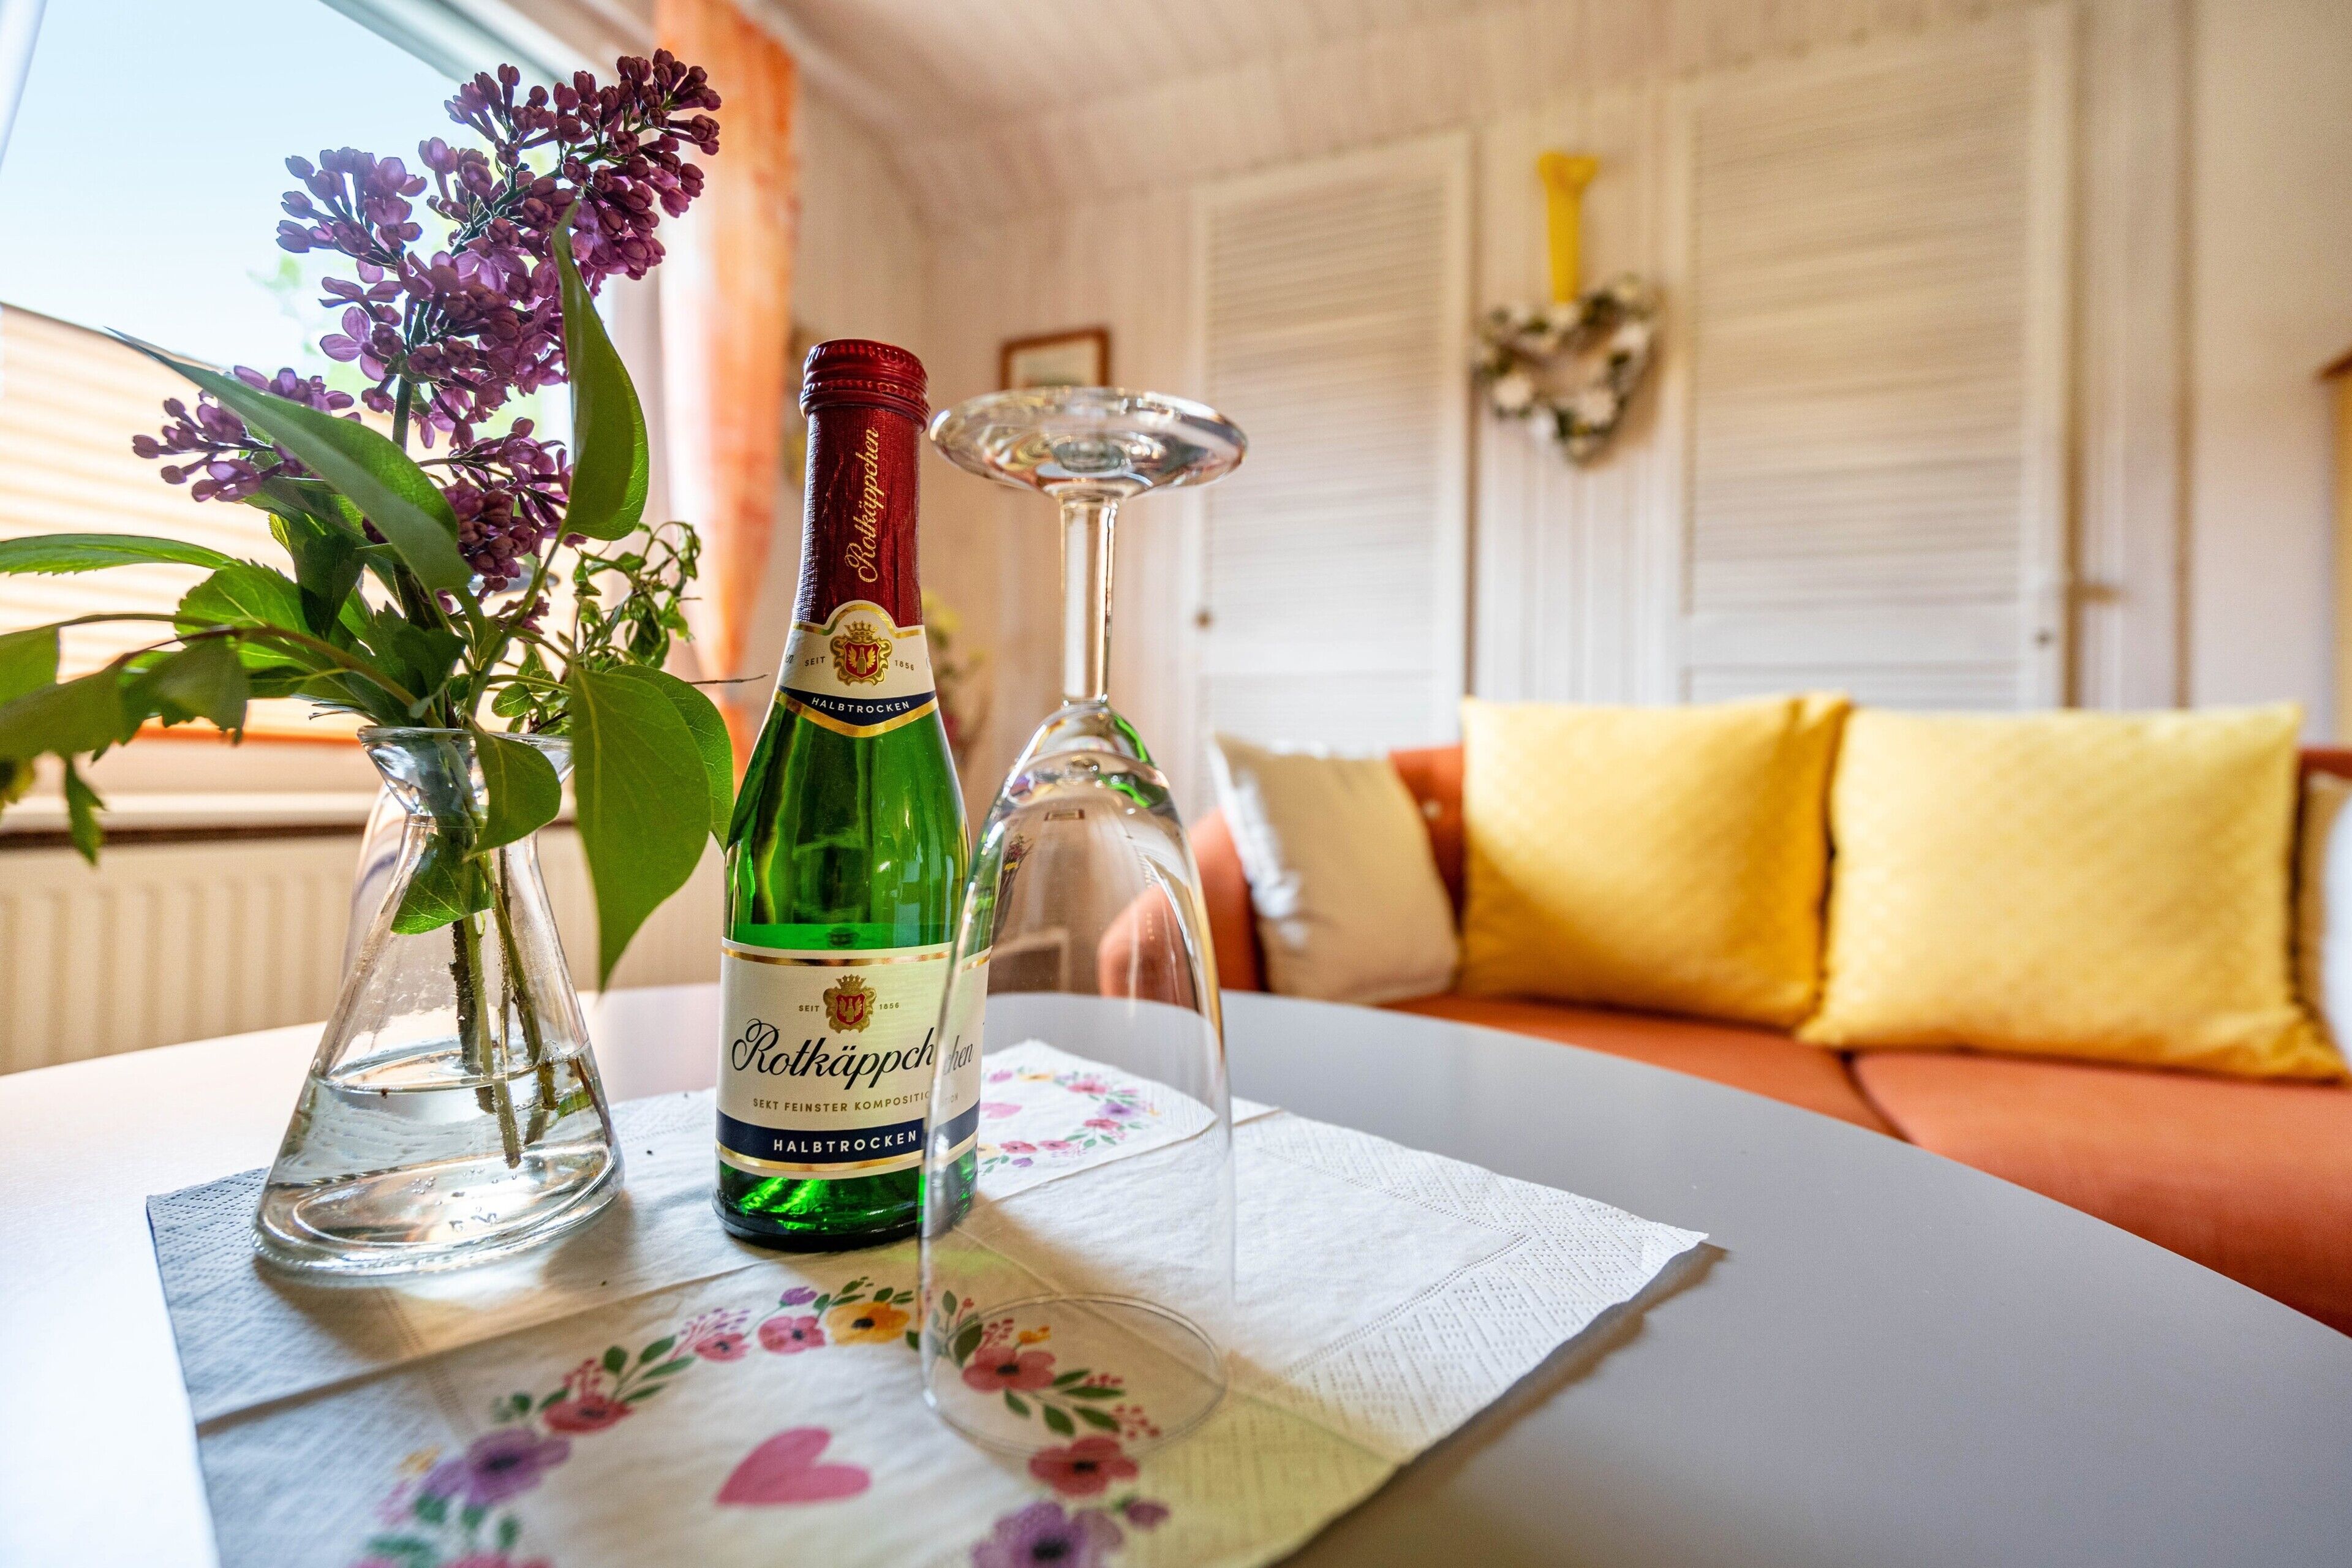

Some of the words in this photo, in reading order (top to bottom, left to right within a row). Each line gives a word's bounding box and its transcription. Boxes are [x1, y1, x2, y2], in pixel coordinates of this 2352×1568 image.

[845, 427, 884, 583] Rotkäppchen
[804, 656, 826, 666] SEIT
[894, 660, 915, 671] 1856
[811, 697, 910, 714] HALBTROCKEN
[753, 1098, 778, 1110] SEKT
[784, 1102, 848, 1112] FEINSTER
[774, 1130, 916, 1153] HALBTROCKEN
